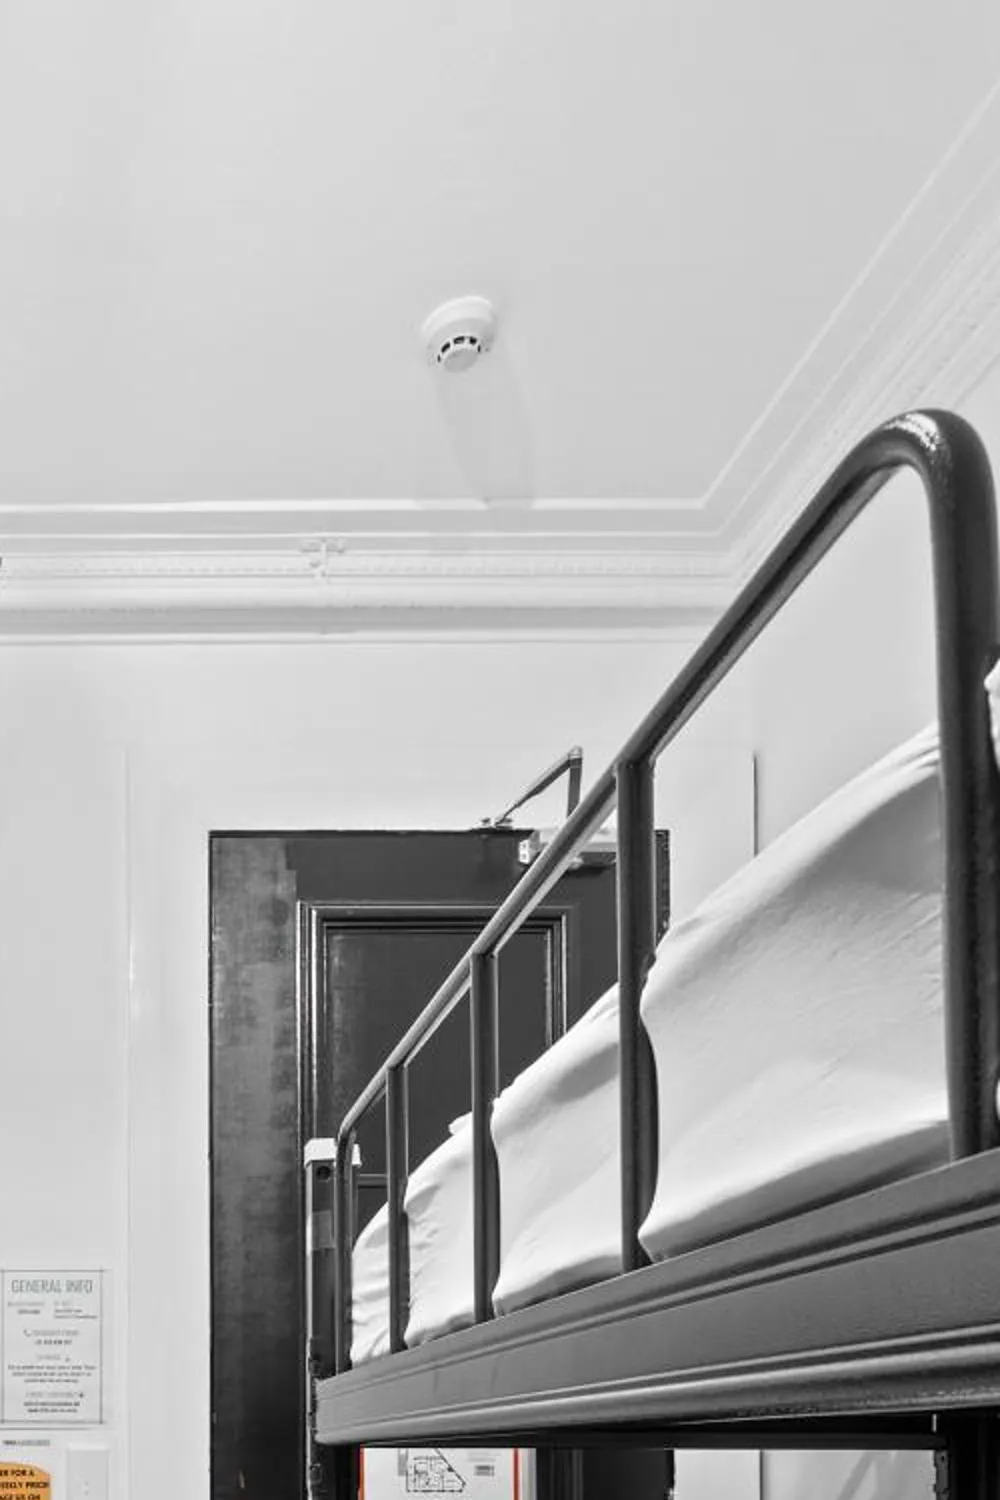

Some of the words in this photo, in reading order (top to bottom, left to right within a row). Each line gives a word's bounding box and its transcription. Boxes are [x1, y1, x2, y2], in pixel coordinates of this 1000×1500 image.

[11, 1279, 61, 1293] GENERAL
[66, 1279, 93, 1293] INFO
[11, 1469, 27, 1477] FOR
[29, 1469, 35, 1477] A
[16, 1493, 26, 1500] US
[28, 1493, 40, 1500] ON
